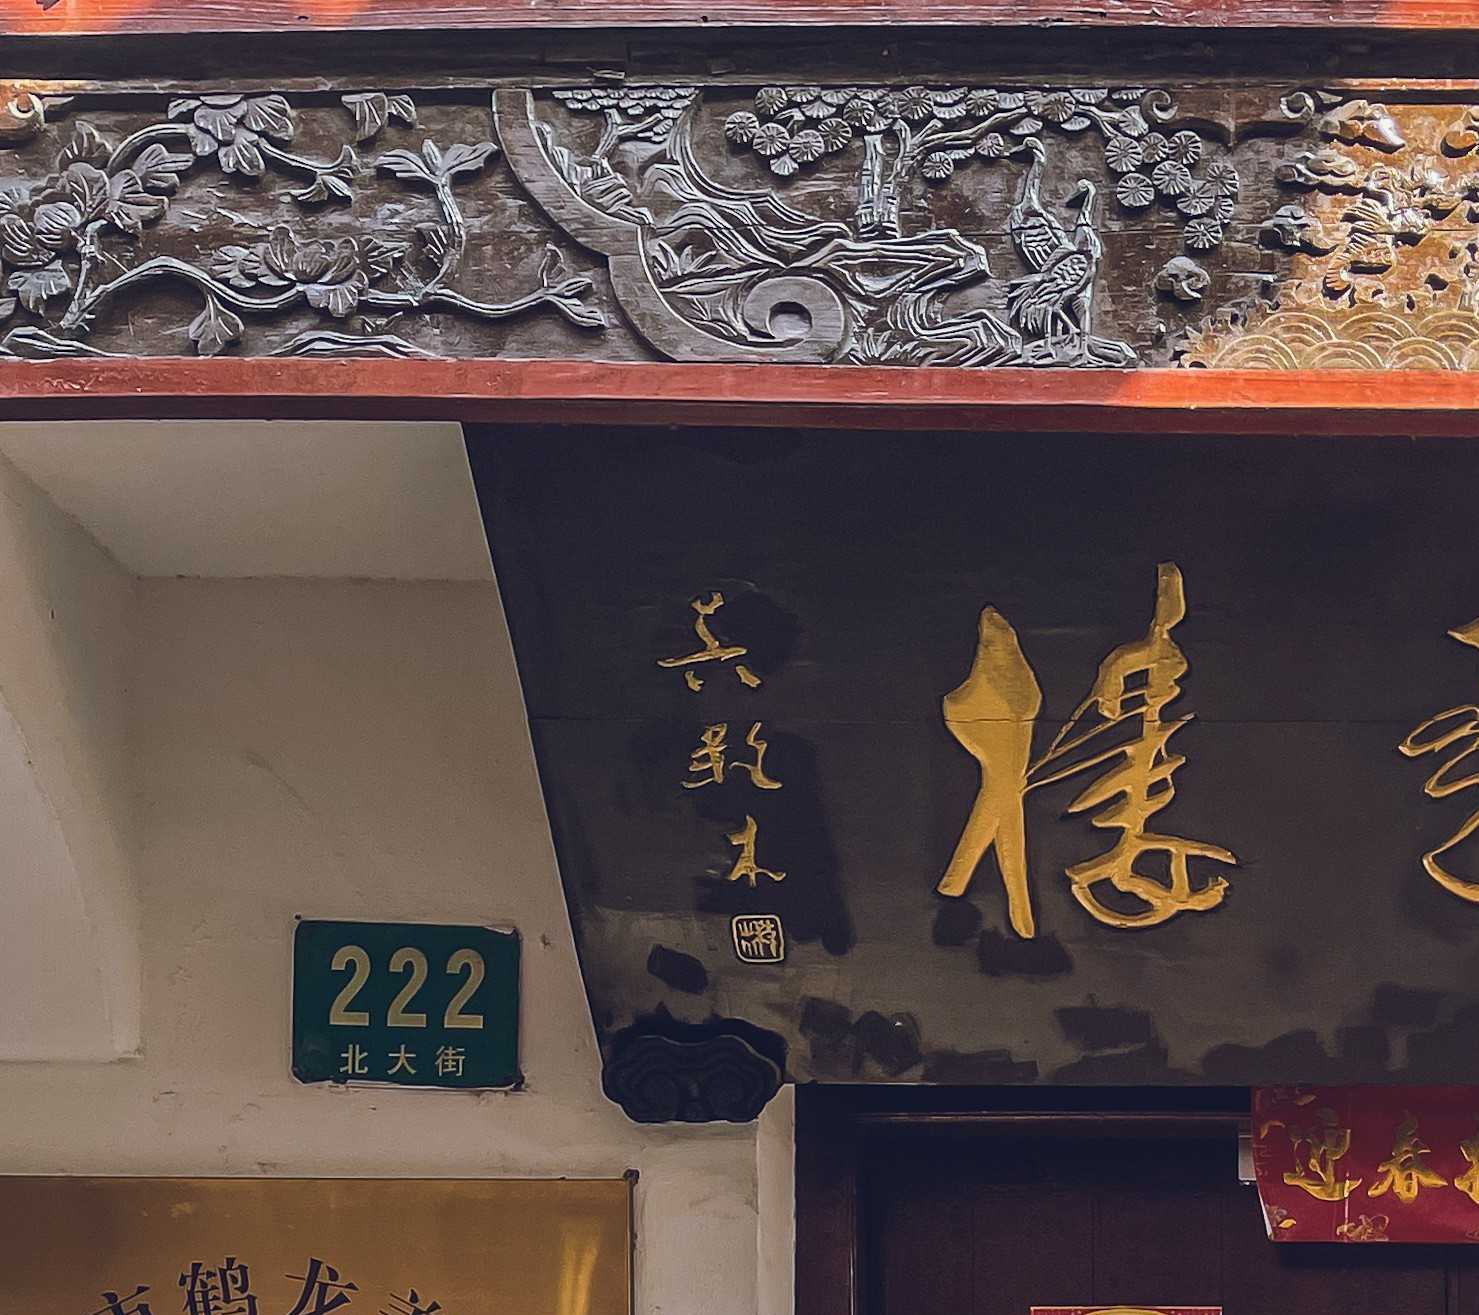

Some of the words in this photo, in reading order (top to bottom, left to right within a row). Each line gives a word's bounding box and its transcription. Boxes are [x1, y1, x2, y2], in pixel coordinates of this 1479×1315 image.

[328, 944, 486, 1030] 222
[339, 1044, 466, 1077] 北大街
